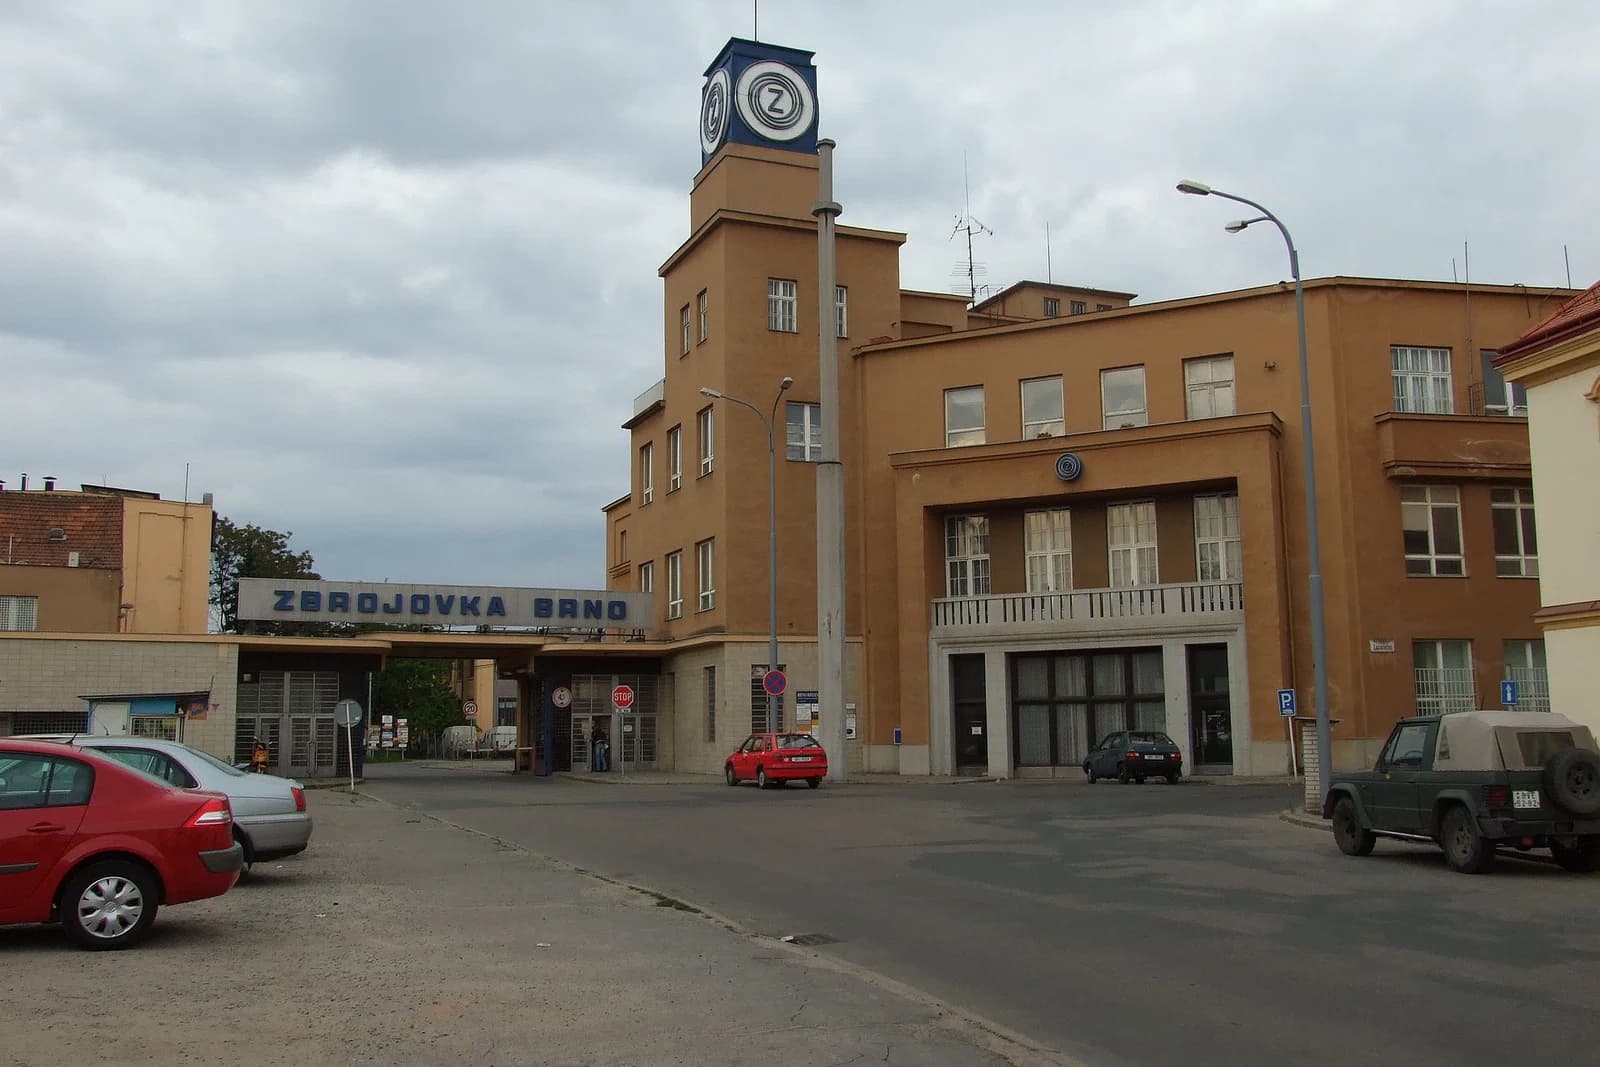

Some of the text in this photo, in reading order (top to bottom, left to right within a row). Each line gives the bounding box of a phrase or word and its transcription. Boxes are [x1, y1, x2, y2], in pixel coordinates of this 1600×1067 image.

[767, 87, 784, 114] Z
[273, 589, 628, 621] ZBROJOVKA BRNO
[614, 692, 632, 702] STOP
[1281, 693, 1292, 709] P
